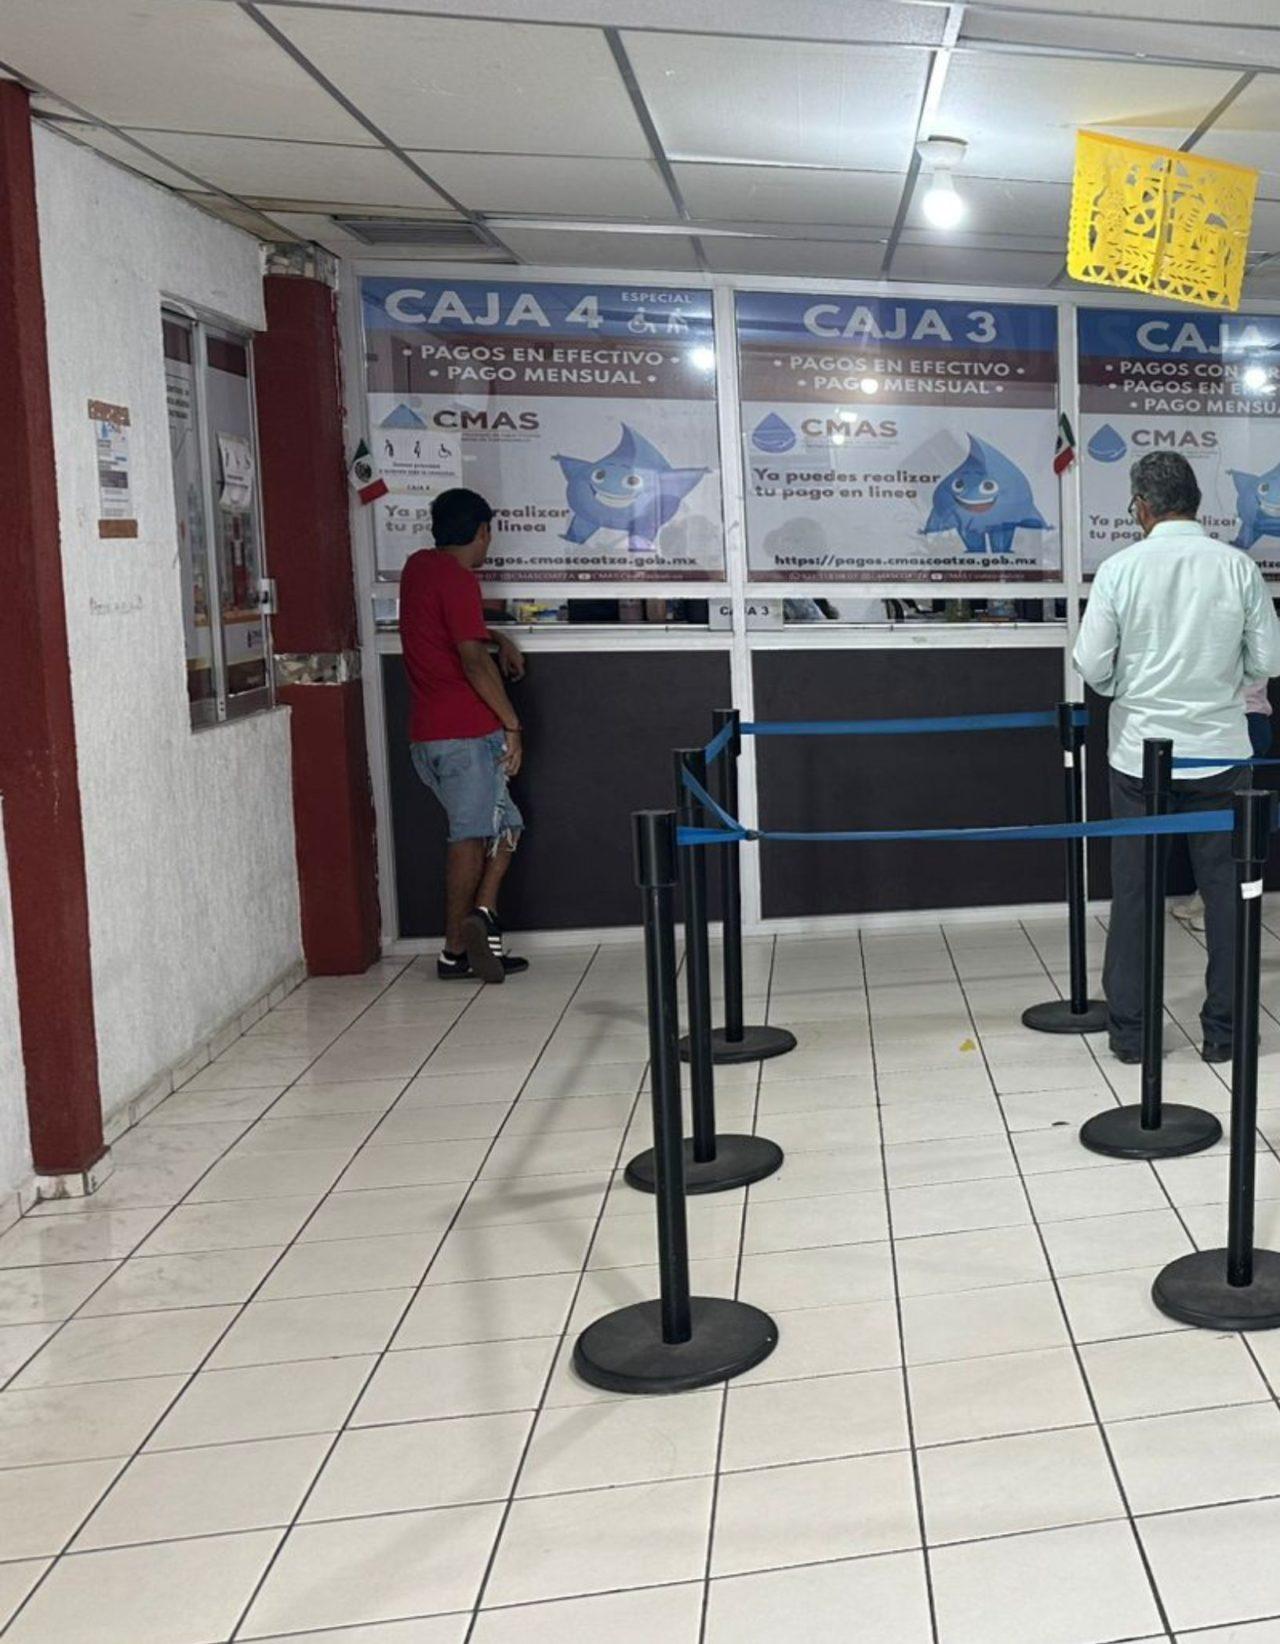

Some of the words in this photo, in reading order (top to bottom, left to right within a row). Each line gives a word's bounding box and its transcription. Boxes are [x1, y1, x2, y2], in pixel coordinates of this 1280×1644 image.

[621, 291, 693, 304] ESPECIAL
[385, 289, 551, 328] CAJA
[565, 296, 604, 329] 4
[803, 304, 953, 341] CAJA
[966, 311, 997, 343] 3
[1136, 320, 1267, 354] CAJA
[421, 346, 506, 362] PAGOS
[513, 348, 547, 363] EN
[553, 349, 664, 366] EFECTIVO
[790, 356, 867, 372] PAGOS
[874, 359, 902, 373] EN
[910, 361, 1010, 376] EFECTIVO
[1120, 361, 1189, 376] PAGOS
[1194, 364, 1238, 377] CON
[448, 366, 515, 382] PAGO
[524, 368, 641, 384] MENSUAL
[814, 376, 878, 393] PAG
[884, 379, 990, 394] MENSUAL
[1124, 380, 1192, 394] PAGOS
[1199, 382, 1224, 395] EN
[1144, 398, 1202, 412] PAGO
[433, 410, 540, 431] CMAS
[801, 418, 898, 438] CMAS
[1131, 429, 1218, 448] CMAS
[754, 468, 780, 481] Ya
[786, 470, 857, 485] puedes
[863, 470, 941, 483] realizar
[755, 486, 776, 497] tu
[782, 487, 834, 500] pago
[840, 487, 863, 498] en
[385, 505, 409, 517] Ya
[385, 522, 407, 532] tu
[1089, 515, 1109, 526] Ya
[1089, 530, 1106, 539] tu
[720, 606, 757, 616] CA
[761, 606, 769, 615] 3
